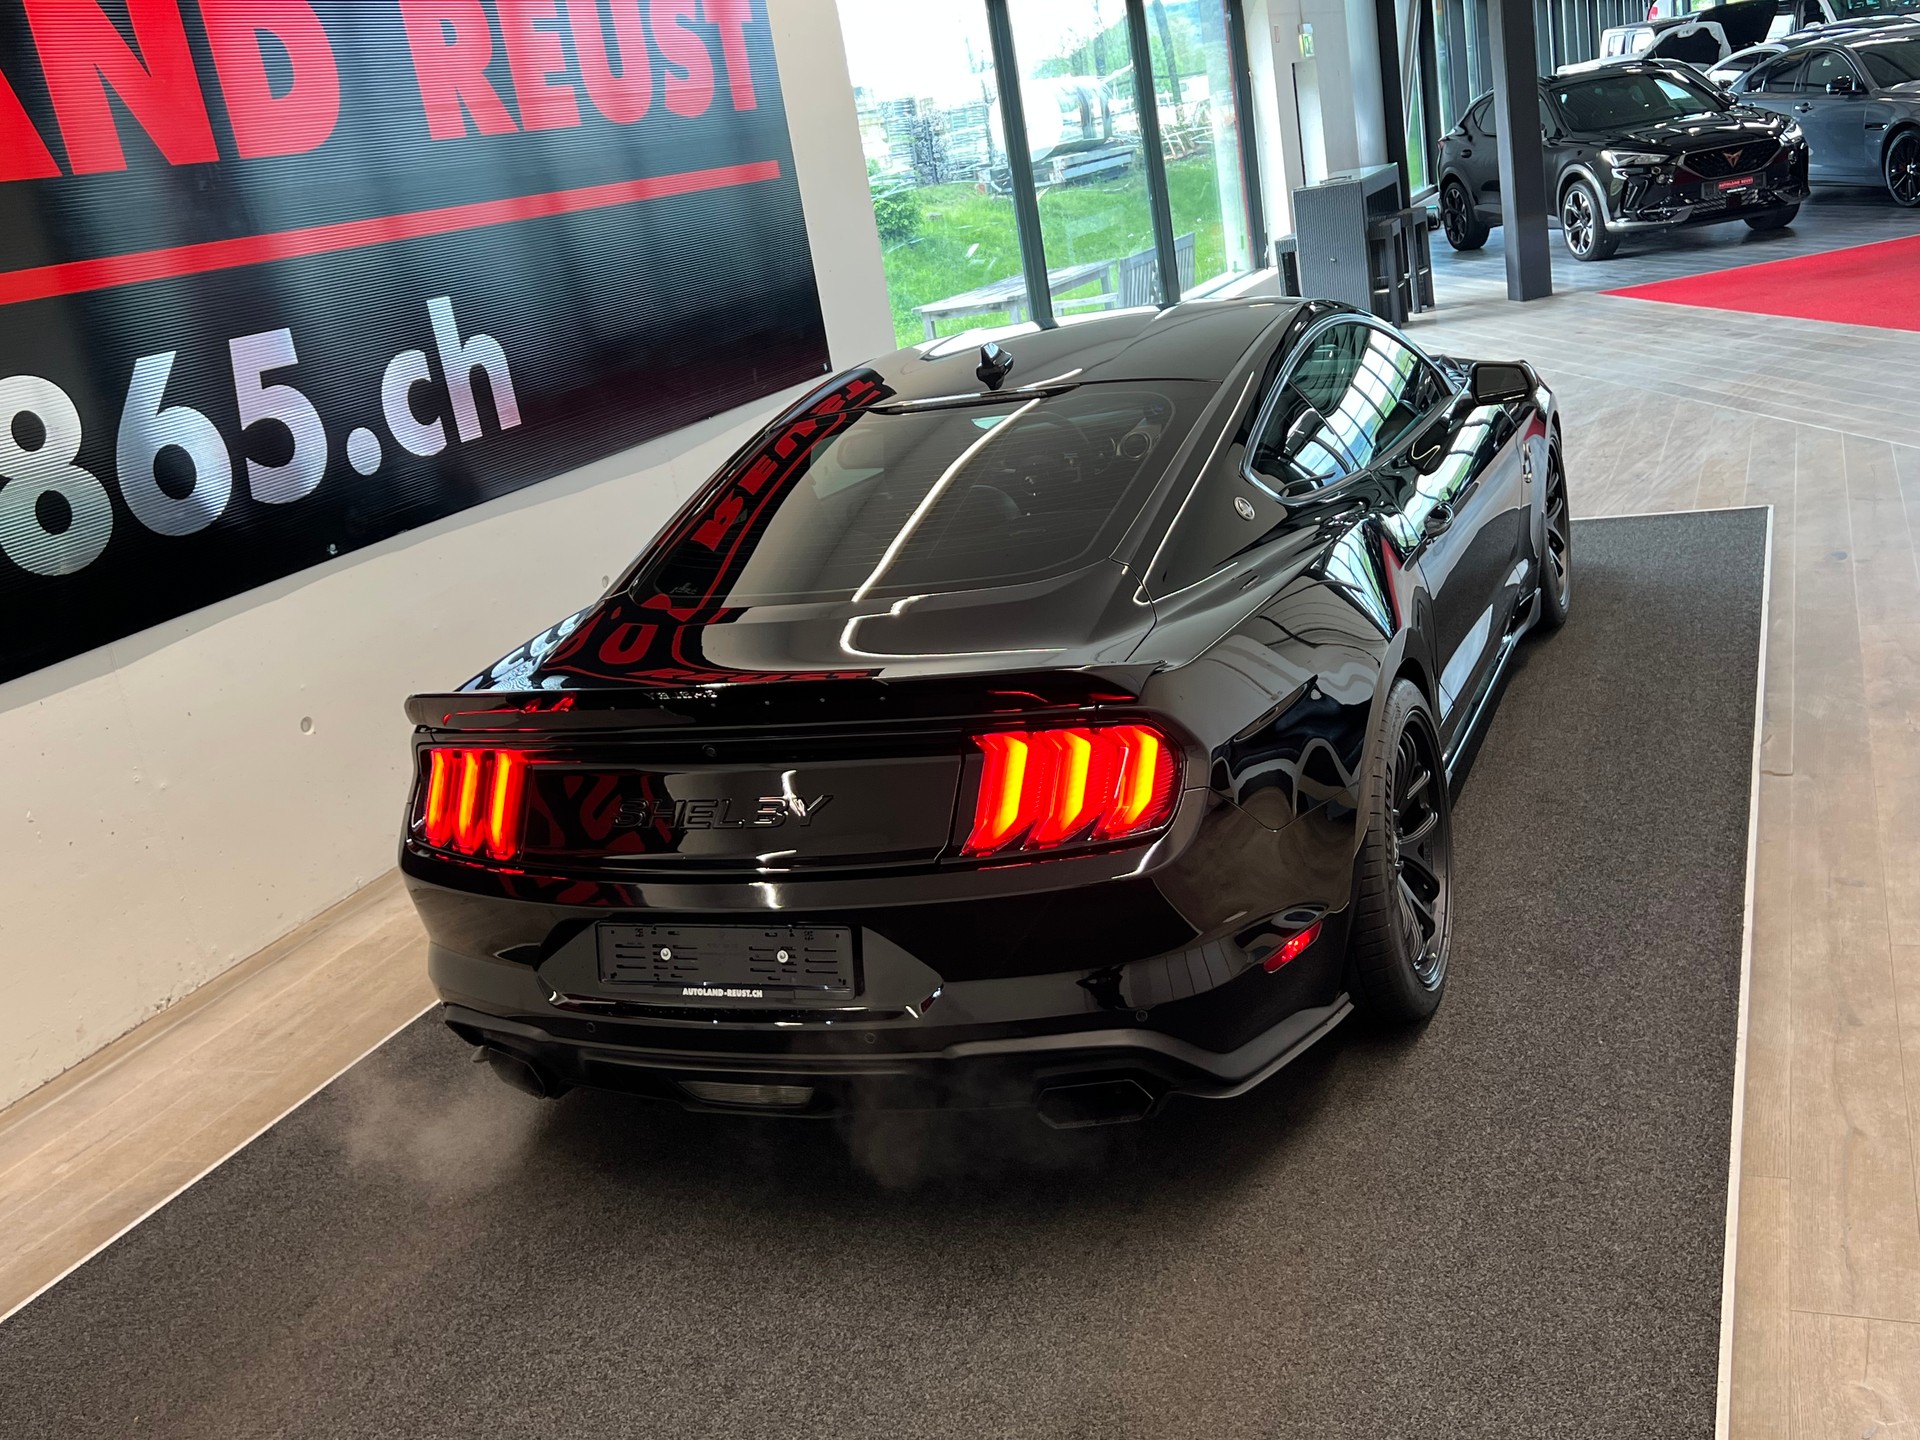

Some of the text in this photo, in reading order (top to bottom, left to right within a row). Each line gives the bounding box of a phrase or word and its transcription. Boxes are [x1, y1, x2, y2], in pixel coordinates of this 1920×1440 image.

[399, 0, 758, 141] REUST
[0, 296, 522, 577] 865.ch
[613, 794, 834, 830] SHELBY
[682, 987, 763, 998] AUTOLAND-REUST.CH
